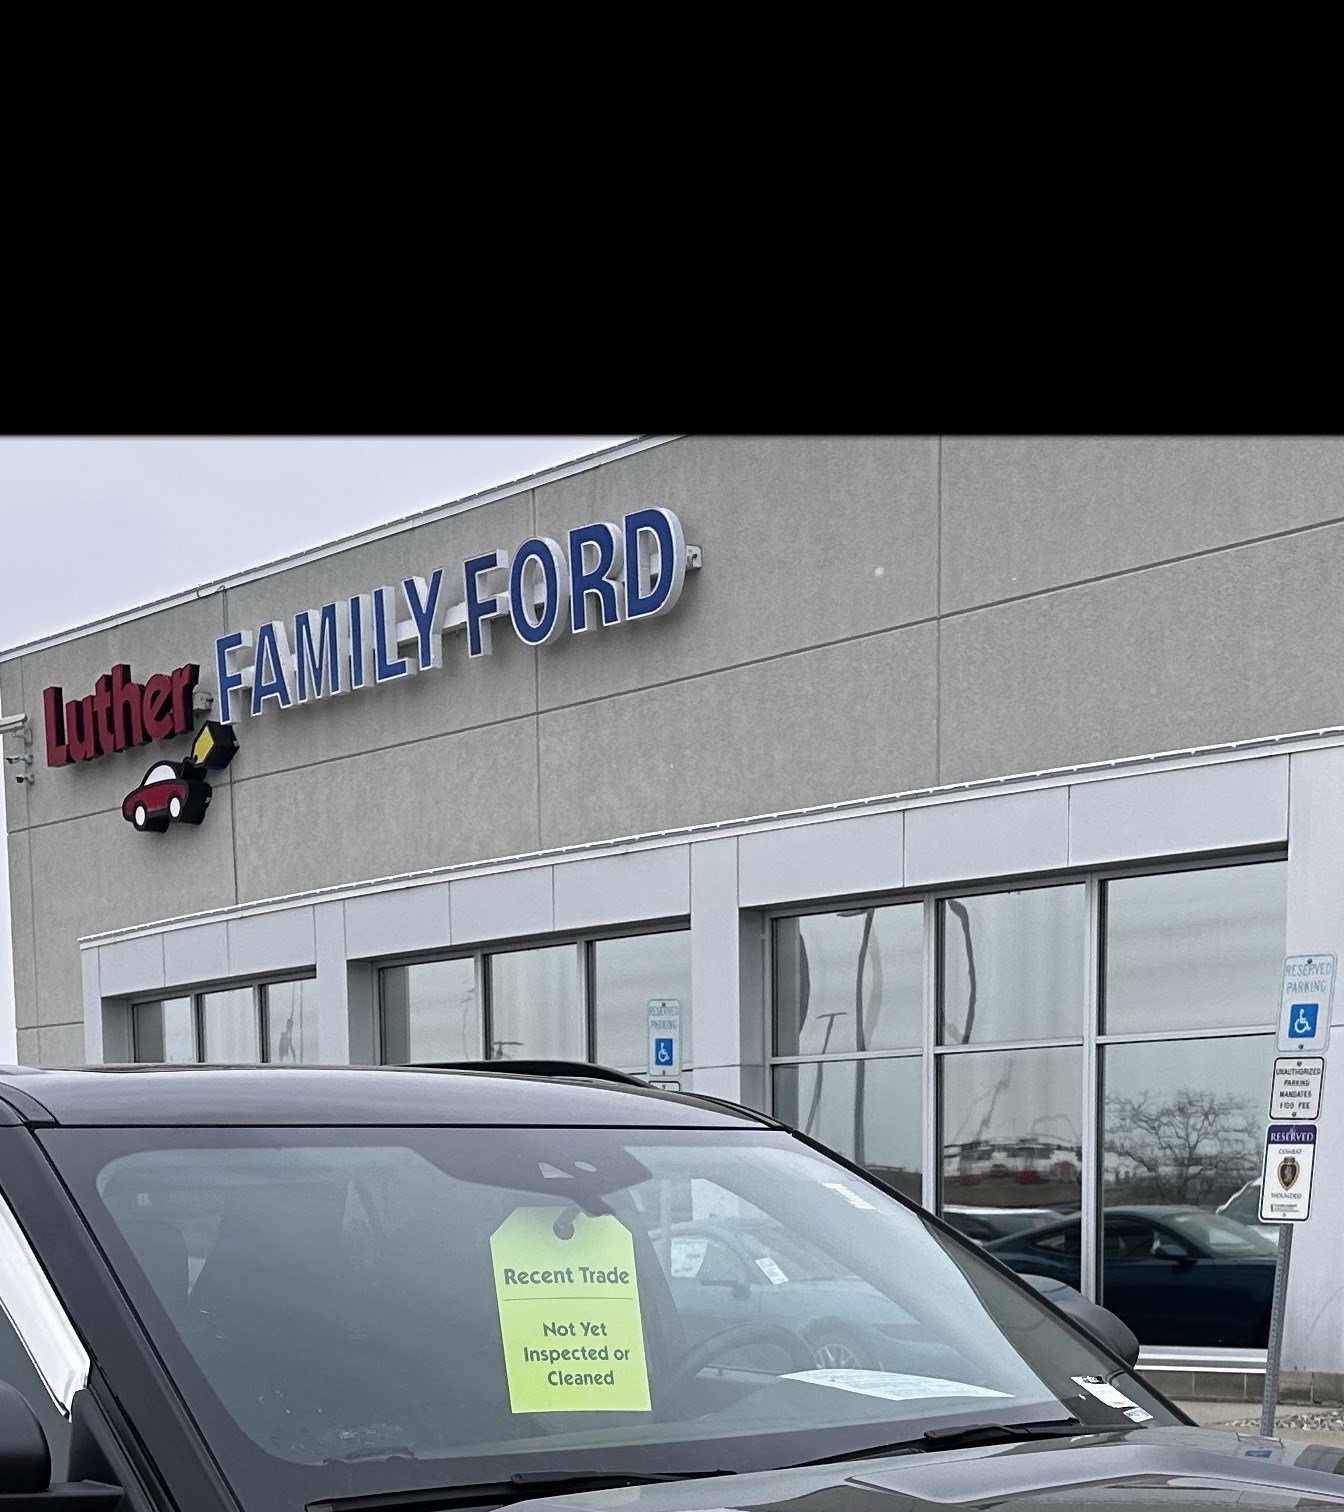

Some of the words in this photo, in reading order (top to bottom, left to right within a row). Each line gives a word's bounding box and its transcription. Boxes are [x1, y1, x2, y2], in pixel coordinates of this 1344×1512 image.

[215, 567, 444, 726] FAMILY
[463, 506, 687, 659] FORD
[43, 663, 201, 767] Luther
[1284, 962, 1332, 977] RESERVED
[1286, 980, 1327, 993] PARKING
[1270, 1132, 1314, 1142] RESERVED
[503, 1268, 574, 1285] Recent
[579, 1266, 630, 1285] Trade
[542, 1321, 576, 1337] Not
[580, 1321, 608, 1337] Yet
[523, 1346, 609, 1364] Inspected
[613, 1348, 631, 1361] or
[547, 1370, 615, 1386] Cleaned
